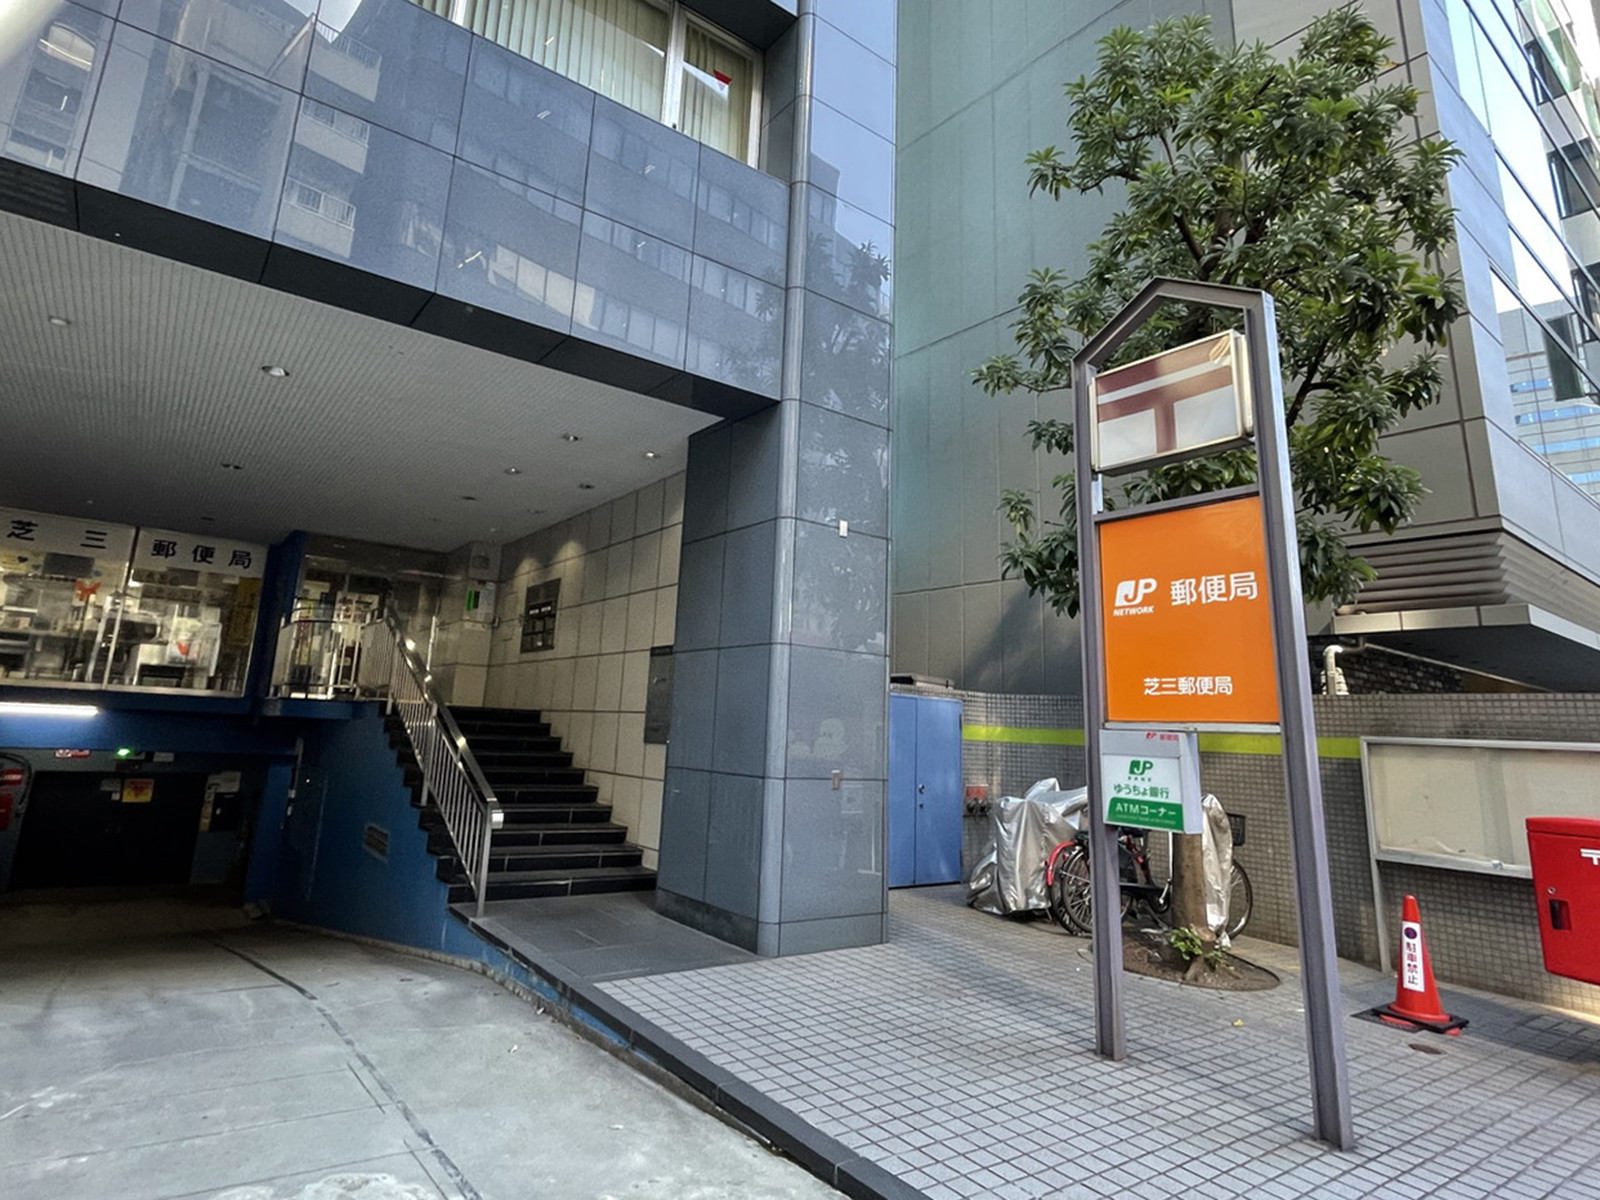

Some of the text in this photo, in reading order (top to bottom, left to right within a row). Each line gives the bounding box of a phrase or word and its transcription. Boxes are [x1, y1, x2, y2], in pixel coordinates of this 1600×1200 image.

[1170, 571, 1258, 606] 郵便局
[1113, 606, 1154, 616] NETWORK
[1143, 676, 1233, 695] 芝三郵便局
[1113, 783, 1170, 799] ゆうちょ銀行
[1115, 802, 1176, 817] ATMコーナー
